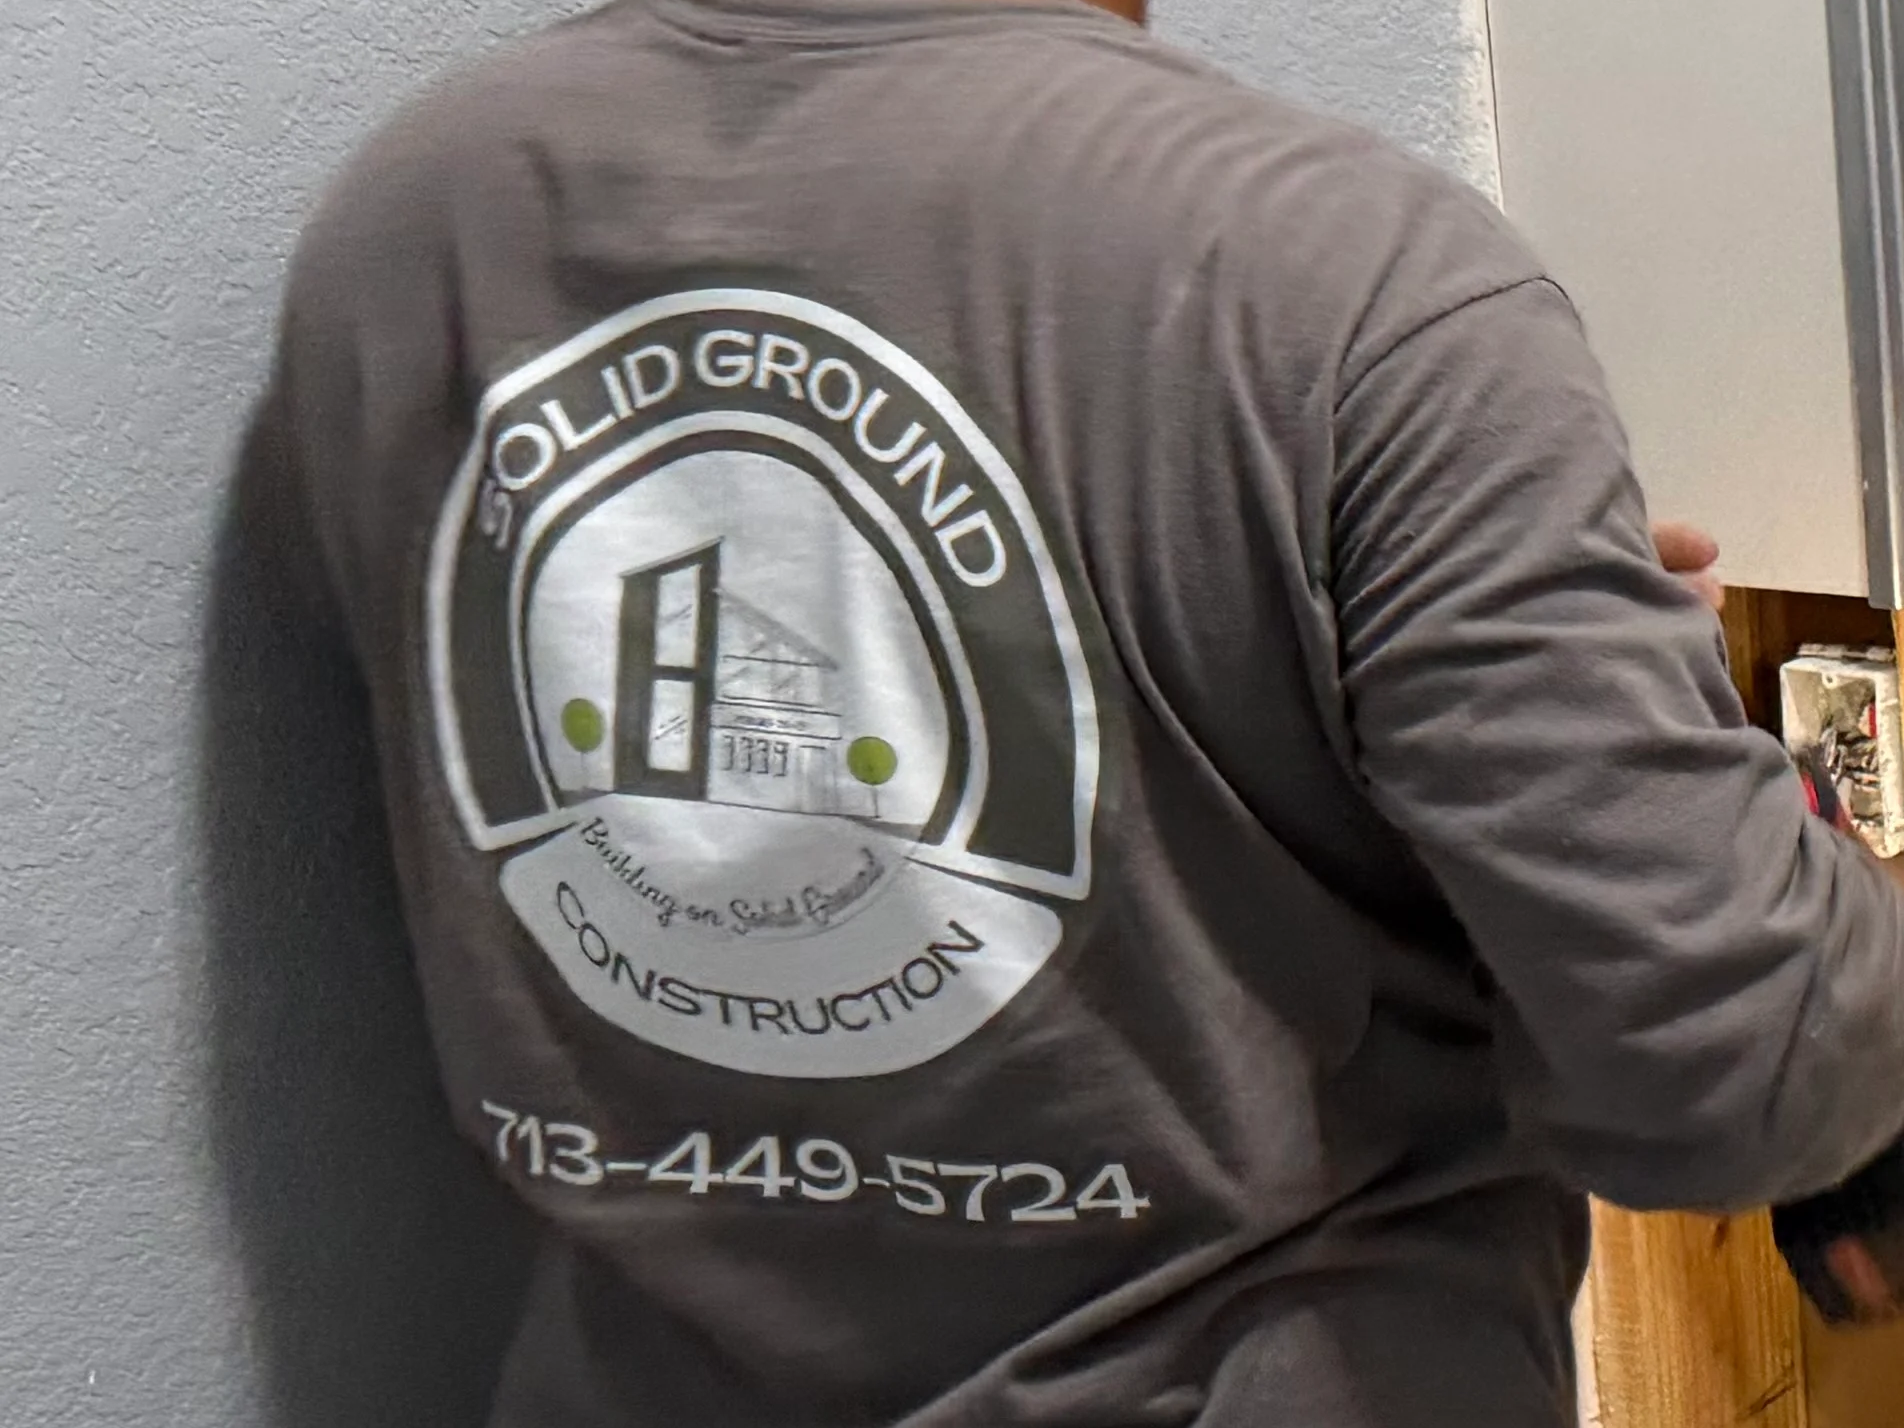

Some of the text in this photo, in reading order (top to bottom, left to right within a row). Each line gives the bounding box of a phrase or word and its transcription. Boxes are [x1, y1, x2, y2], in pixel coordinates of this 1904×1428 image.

[481, 331, 1006, 588] SOLID GROUND
[580, 816, 681, 927] Building
[555, 880, 986, 1037] CONSTRUCTION
[480, 1100, 1151, 1223] 713-449-5724
